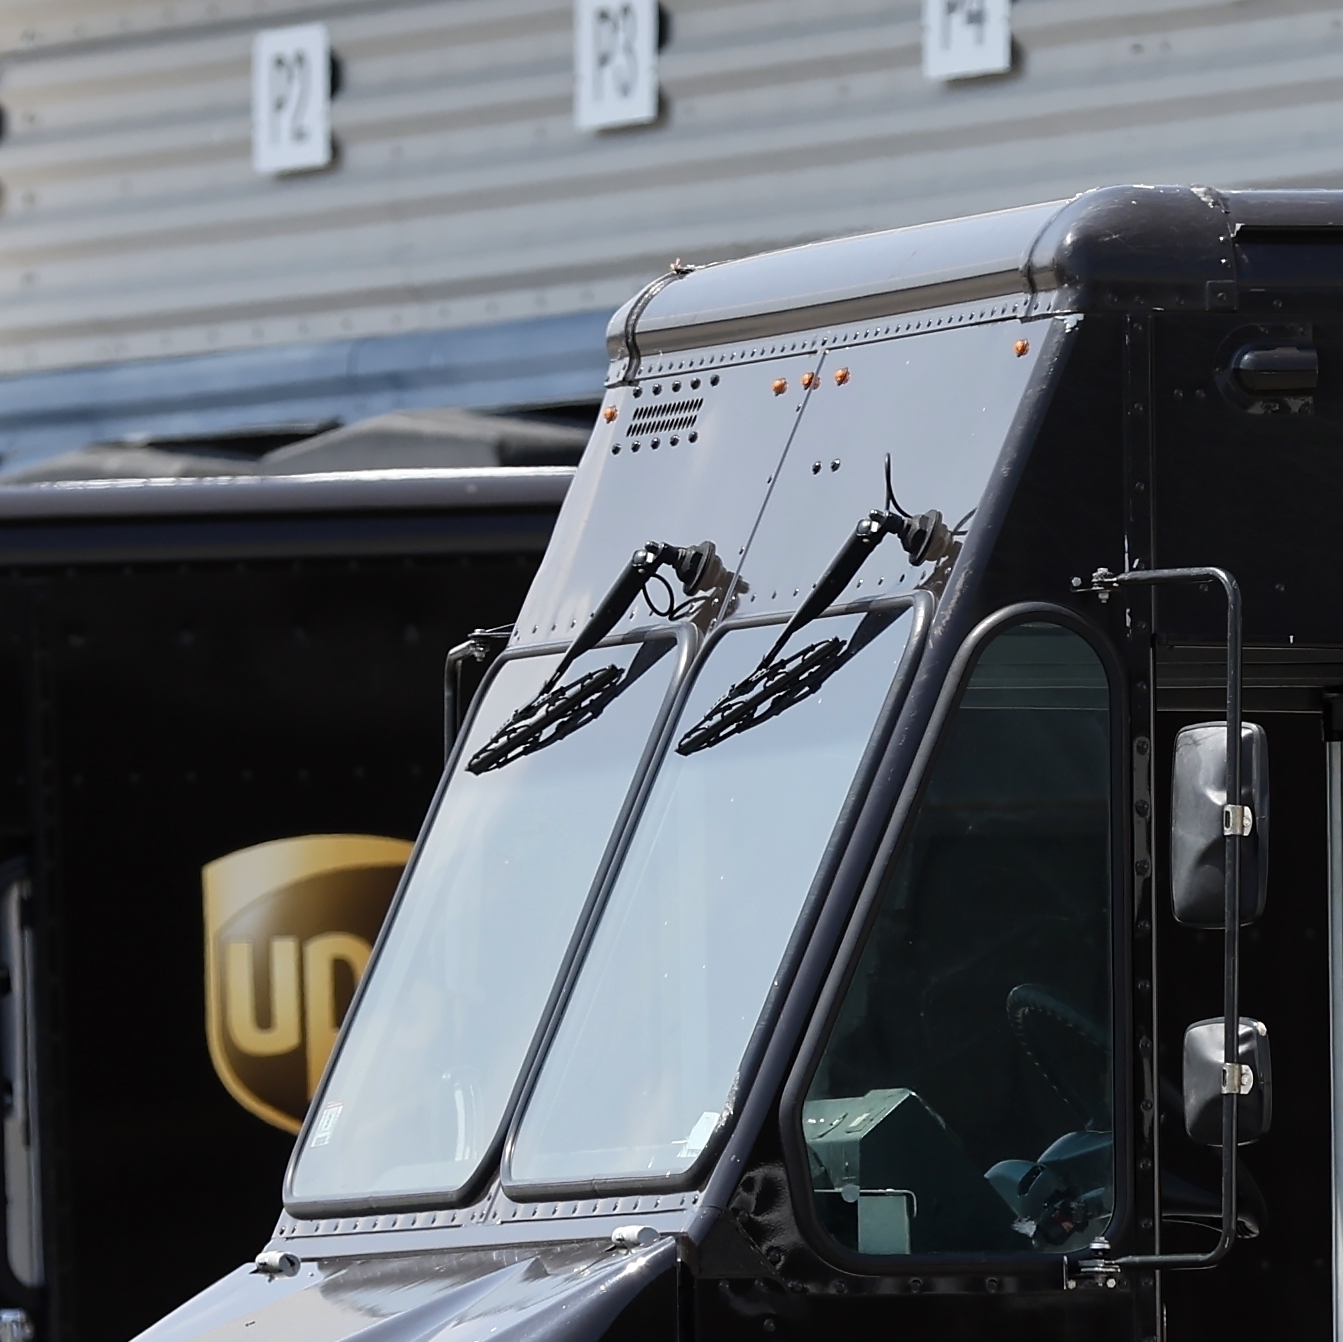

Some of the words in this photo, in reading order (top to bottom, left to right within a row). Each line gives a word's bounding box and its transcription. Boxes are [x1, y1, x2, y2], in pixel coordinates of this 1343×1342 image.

[269, 52, 309, 145] P2
[592, 3, 637, 103] P3
[225, 931, 375, 1101] up
